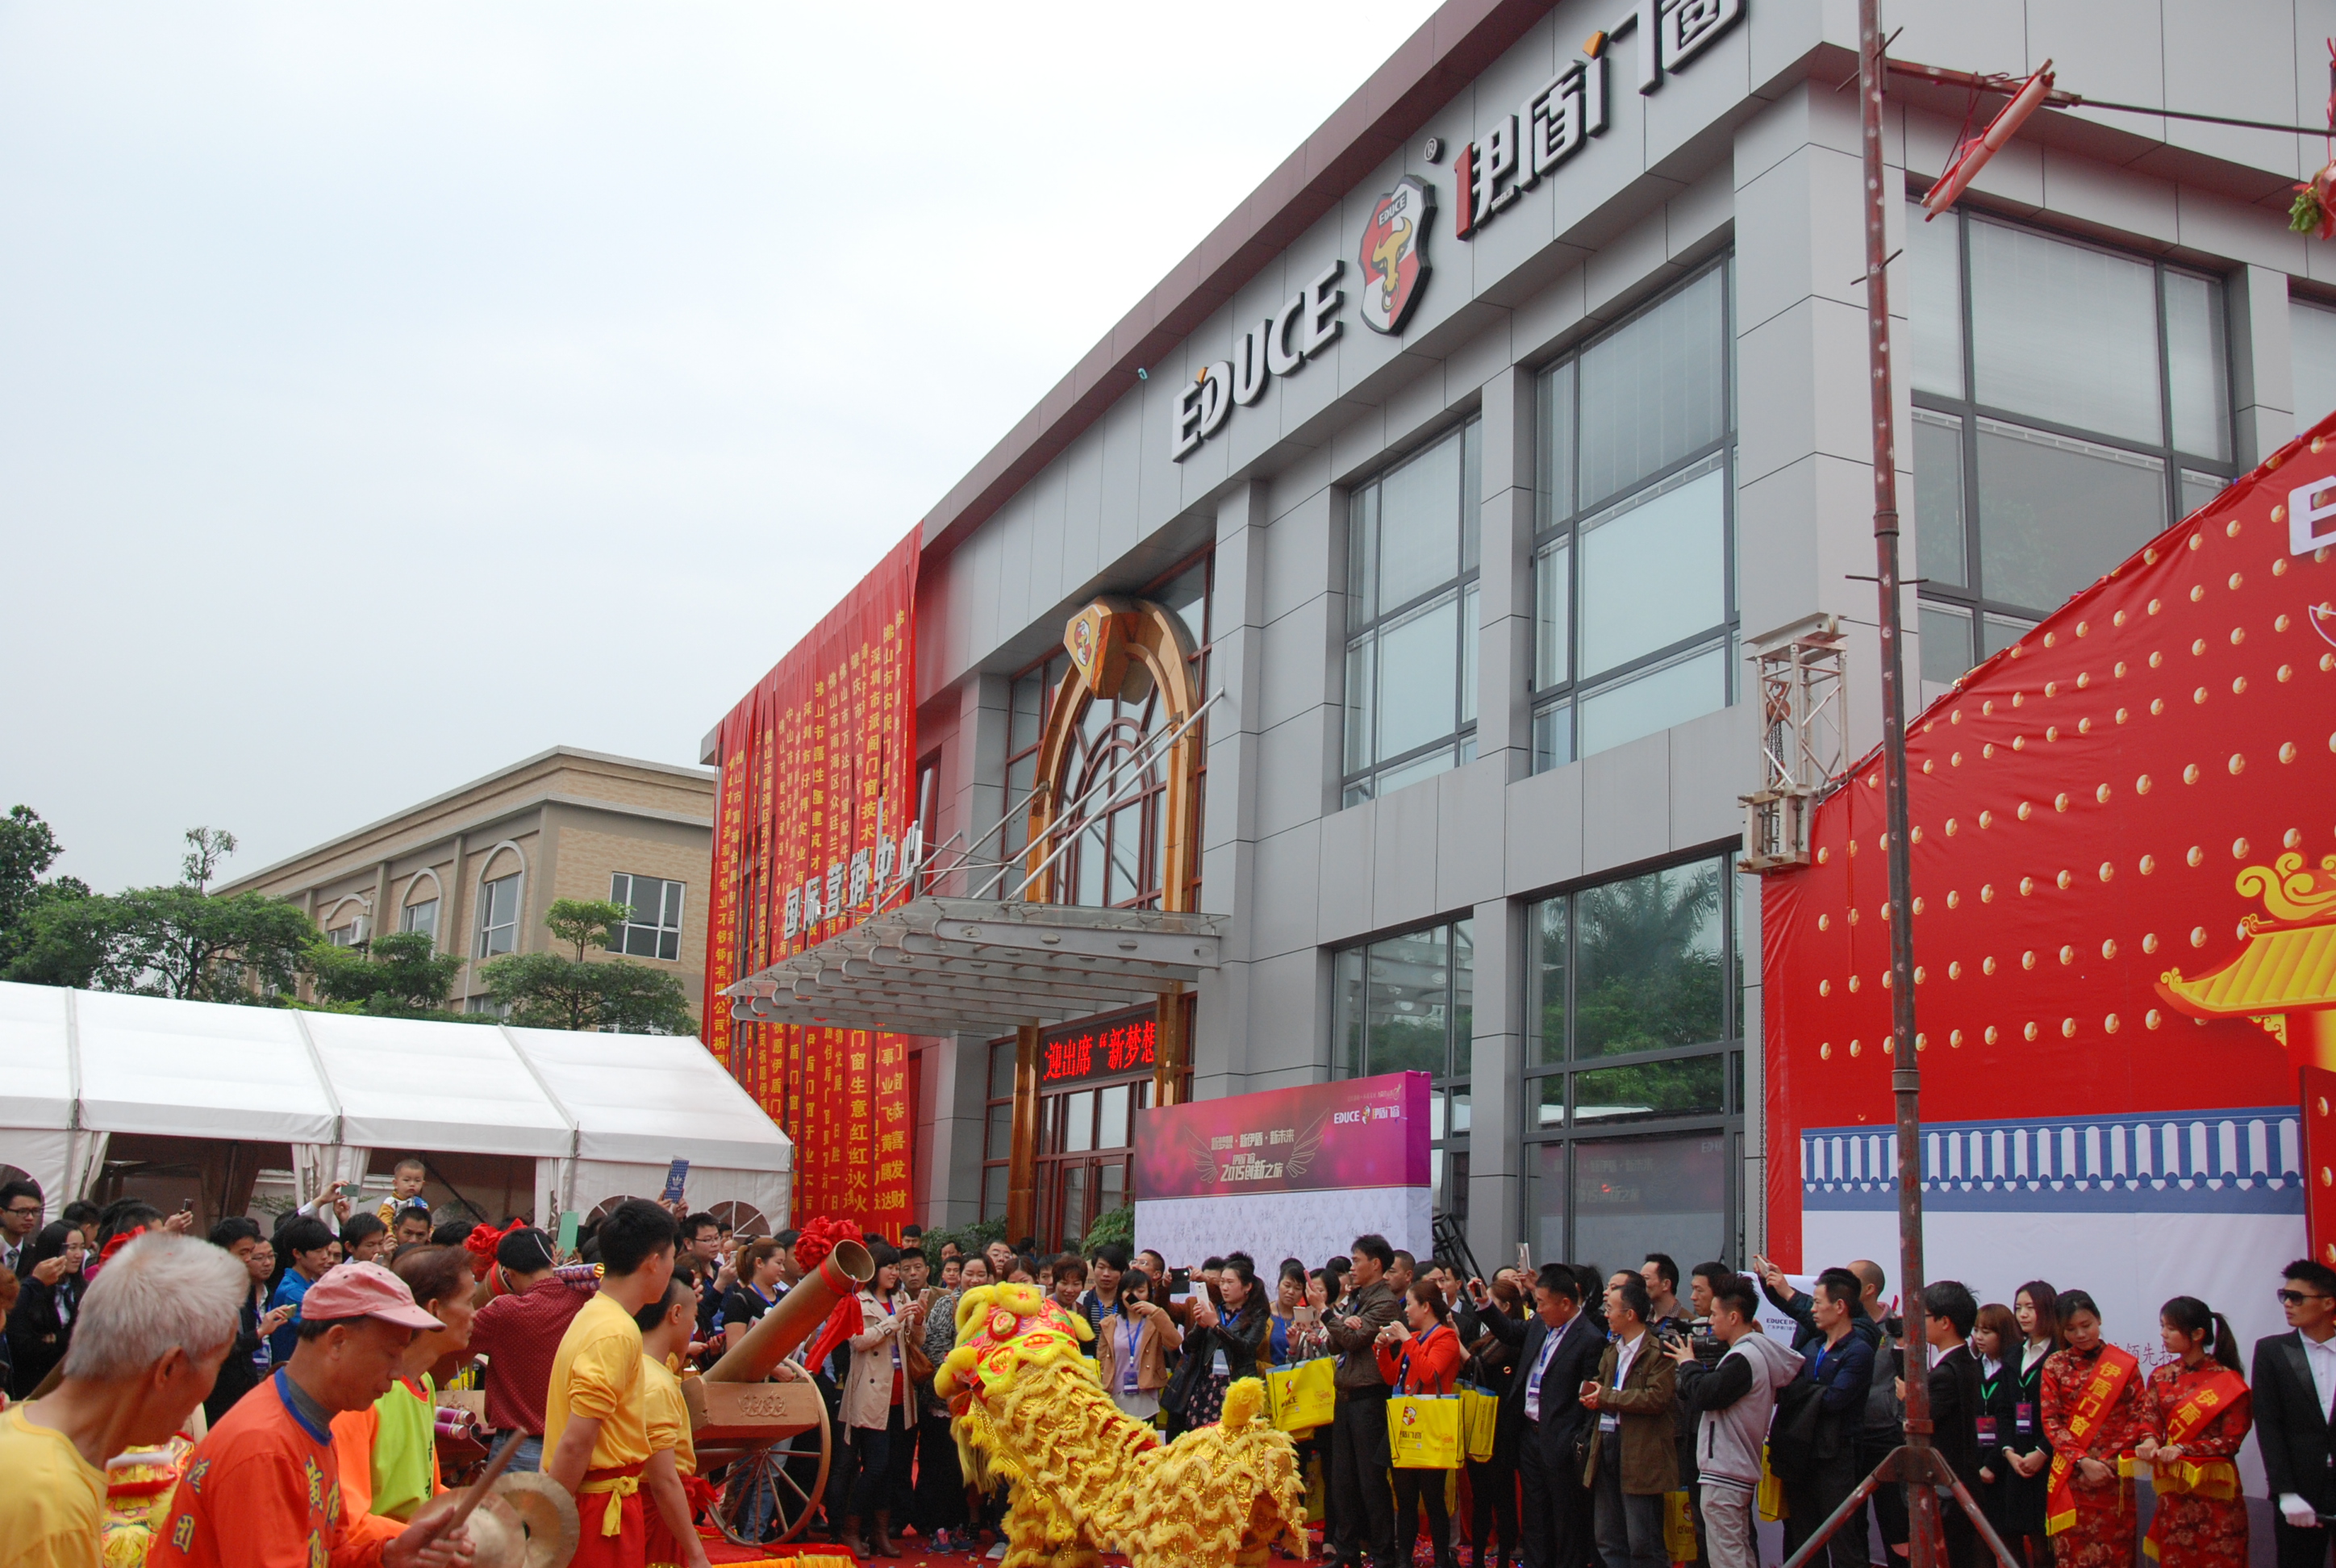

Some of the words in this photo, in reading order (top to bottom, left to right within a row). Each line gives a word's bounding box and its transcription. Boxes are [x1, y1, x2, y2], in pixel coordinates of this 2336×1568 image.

[1378, 194, 1407, 227] EDUCE
[1172, 259, 1345, 462] EDUCE
[783, 820, 923, 940] 国际营销中心
[1333, 1109, 1360, 1124] EDUCE
[1372, 1105, 1400, 1120] 伊盾门窗
[1220, 1159, 1284, 1182] 2015创新之旅
[1233, 1153, 1256, 1165] 伊盾门窗
[2069, 1362, 2121, 1437] 伊盾门窗
[2167, 1388, 2219, 1446] 伊盾门
